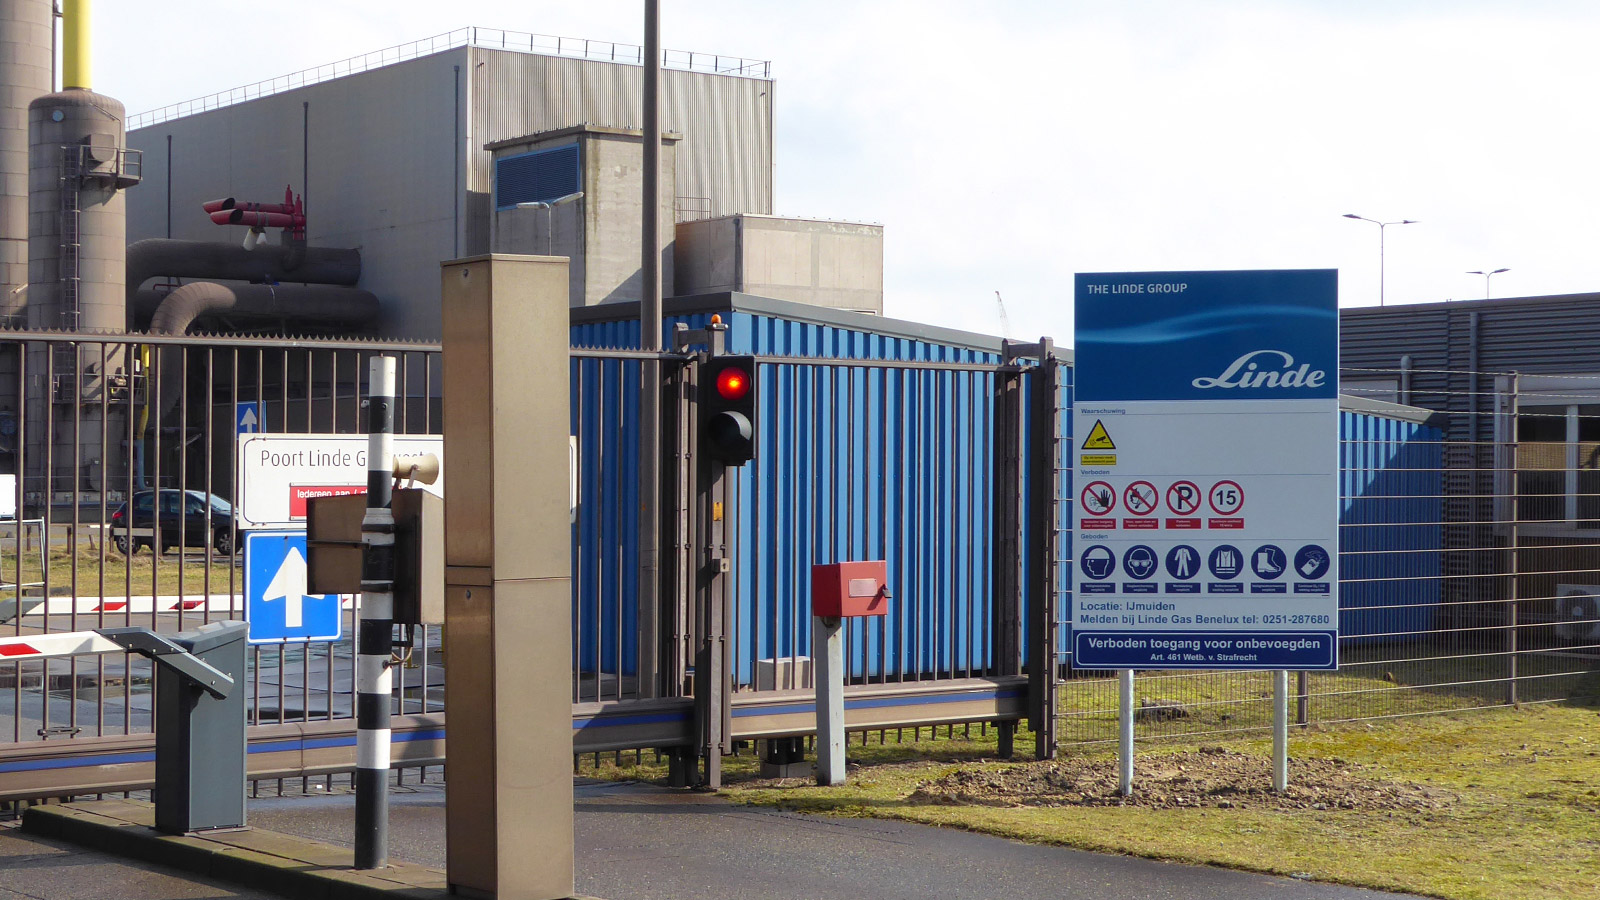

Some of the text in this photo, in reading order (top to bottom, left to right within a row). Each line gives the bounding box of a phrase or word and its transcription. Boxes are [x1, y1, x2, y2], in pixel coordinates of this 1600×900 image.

[1087, 283, 1188, 294] THE LINDE GROUP
[1191, 349, 1326, 389] Linde
[261, 449, 304, 467] Poort
[309, 448, 351, 467] Linde
[1216, 490, 1237, 506] 15
[1080, 601, 1176, 611] Locatie: IJmuiden
[1080, 614, 1330, 626] Melden bij Linde Gas Benelux tel: 0251-287680
[1088, 637, 1321, 651] Verboden toegang voor onbevoegden
[1150, 653, 1165, 661] Art.
[1167, 653, 1181, 661] 461
[1183, 653, 1207, 661] Wetb.
[1217, 653, 1258, 661] Strafrecht
